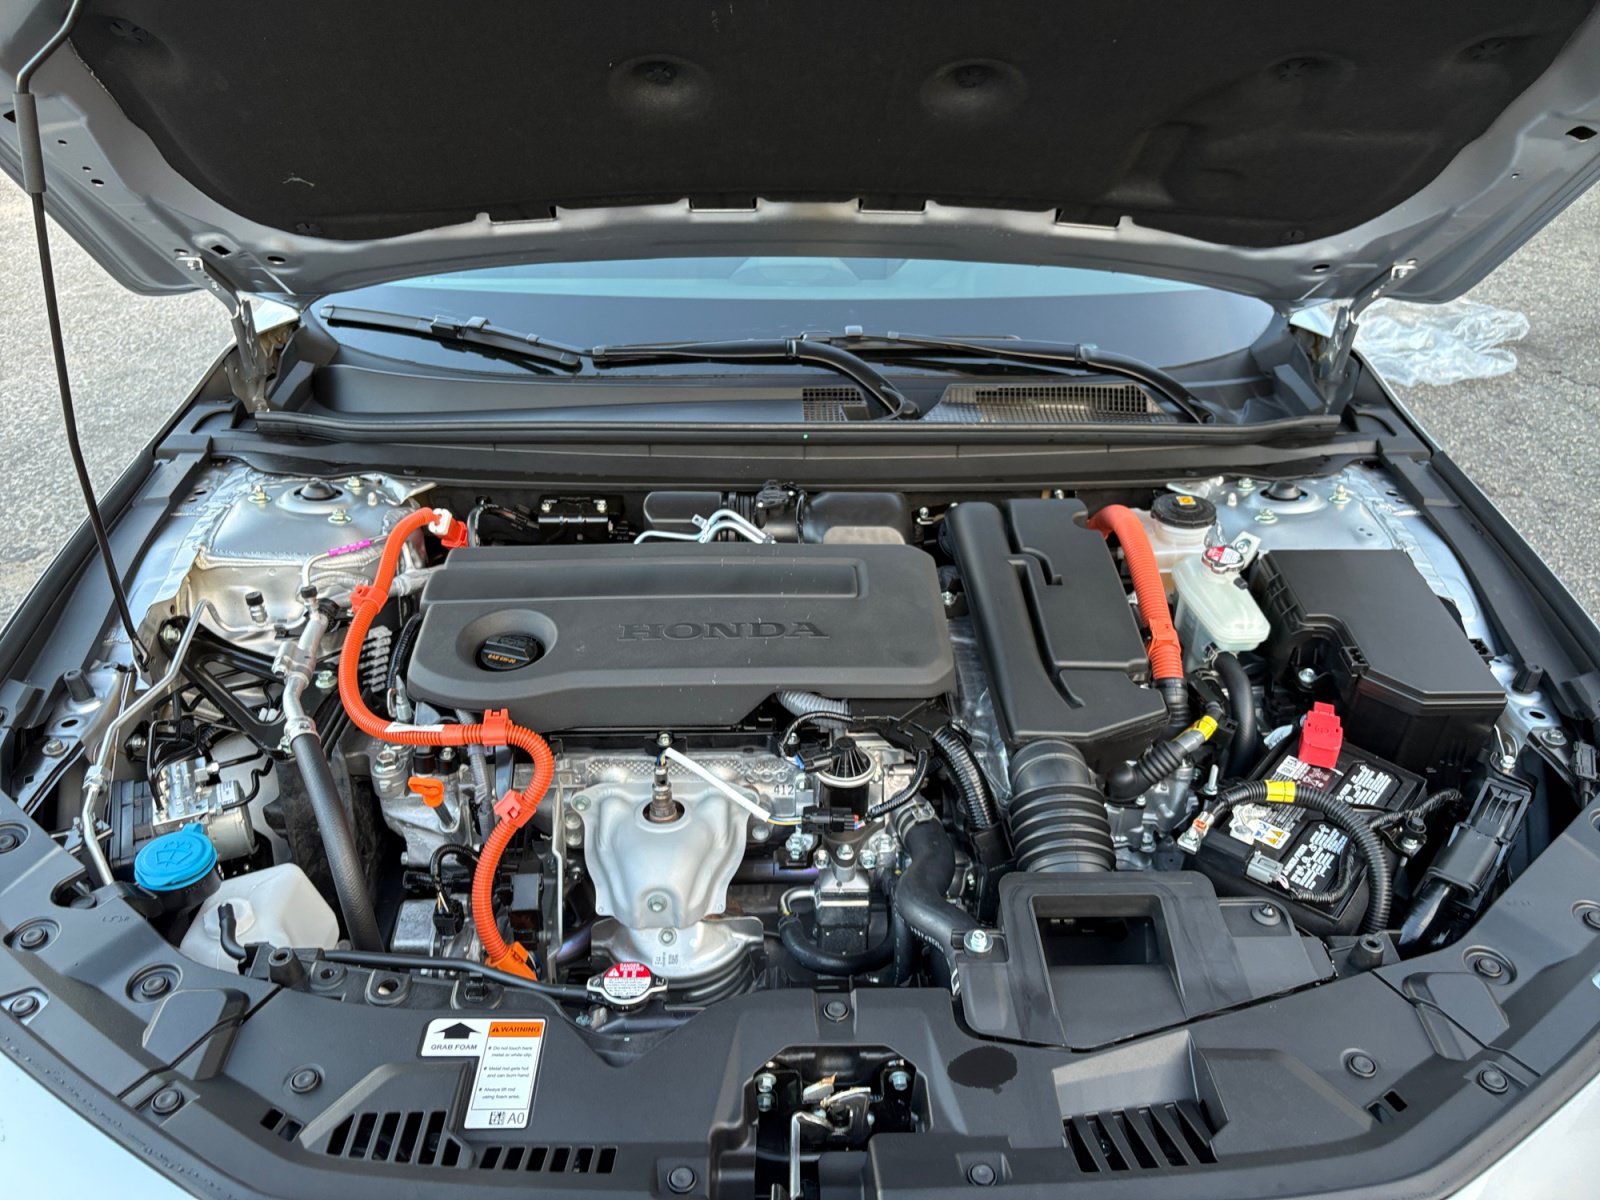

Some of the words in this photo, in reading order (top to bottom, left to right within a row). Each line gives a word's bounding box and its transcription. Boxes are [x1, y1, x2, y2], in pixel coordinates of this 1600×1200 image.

[616, 622, 830, 641] HONDA
[773, 783, 795, 796] 412
[507, 1112, 525, 1125] A0
